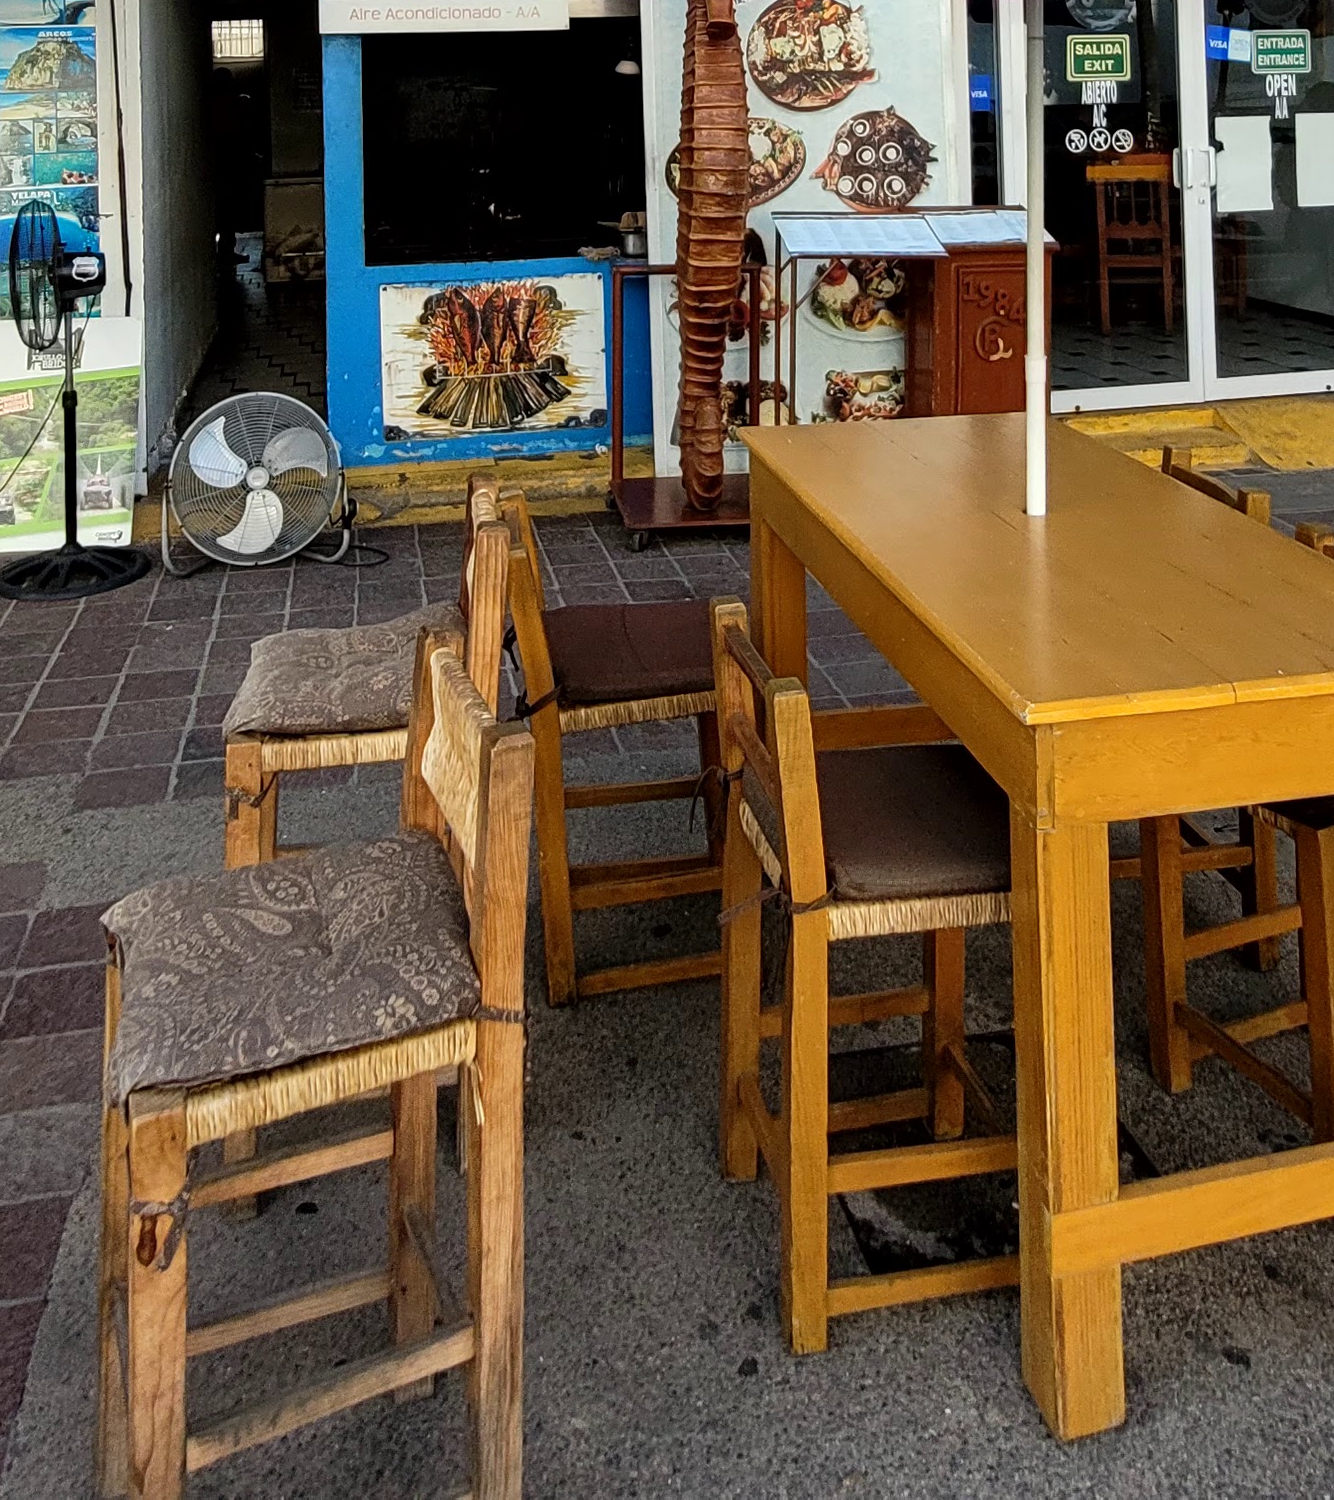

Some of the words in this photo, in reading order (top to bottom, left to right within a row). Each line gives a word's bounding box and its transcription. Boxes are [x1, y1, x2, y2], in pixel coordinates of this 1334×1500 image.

[349, 7, 381, 21] Aire
[385, 6, 502, 21] Acondicionado
[516, 6, 541, 18] A/A
[1208, 38, 1228, 49] VISA
[1257, 37, 1305, 49] ENTRADA
[1075, 43, 1122, 56] SALIDA
[1084, 60, 1115, 71] EXIT
[1258, 53, 1306, 66] ENTRANCE
[1265, 74, 1297, 96] OPEN
[971, 90, 988, 98] VISA
[1081, 81, 1118, 105] ABIERTO
[11, 190, 52, 200] YELAPA
